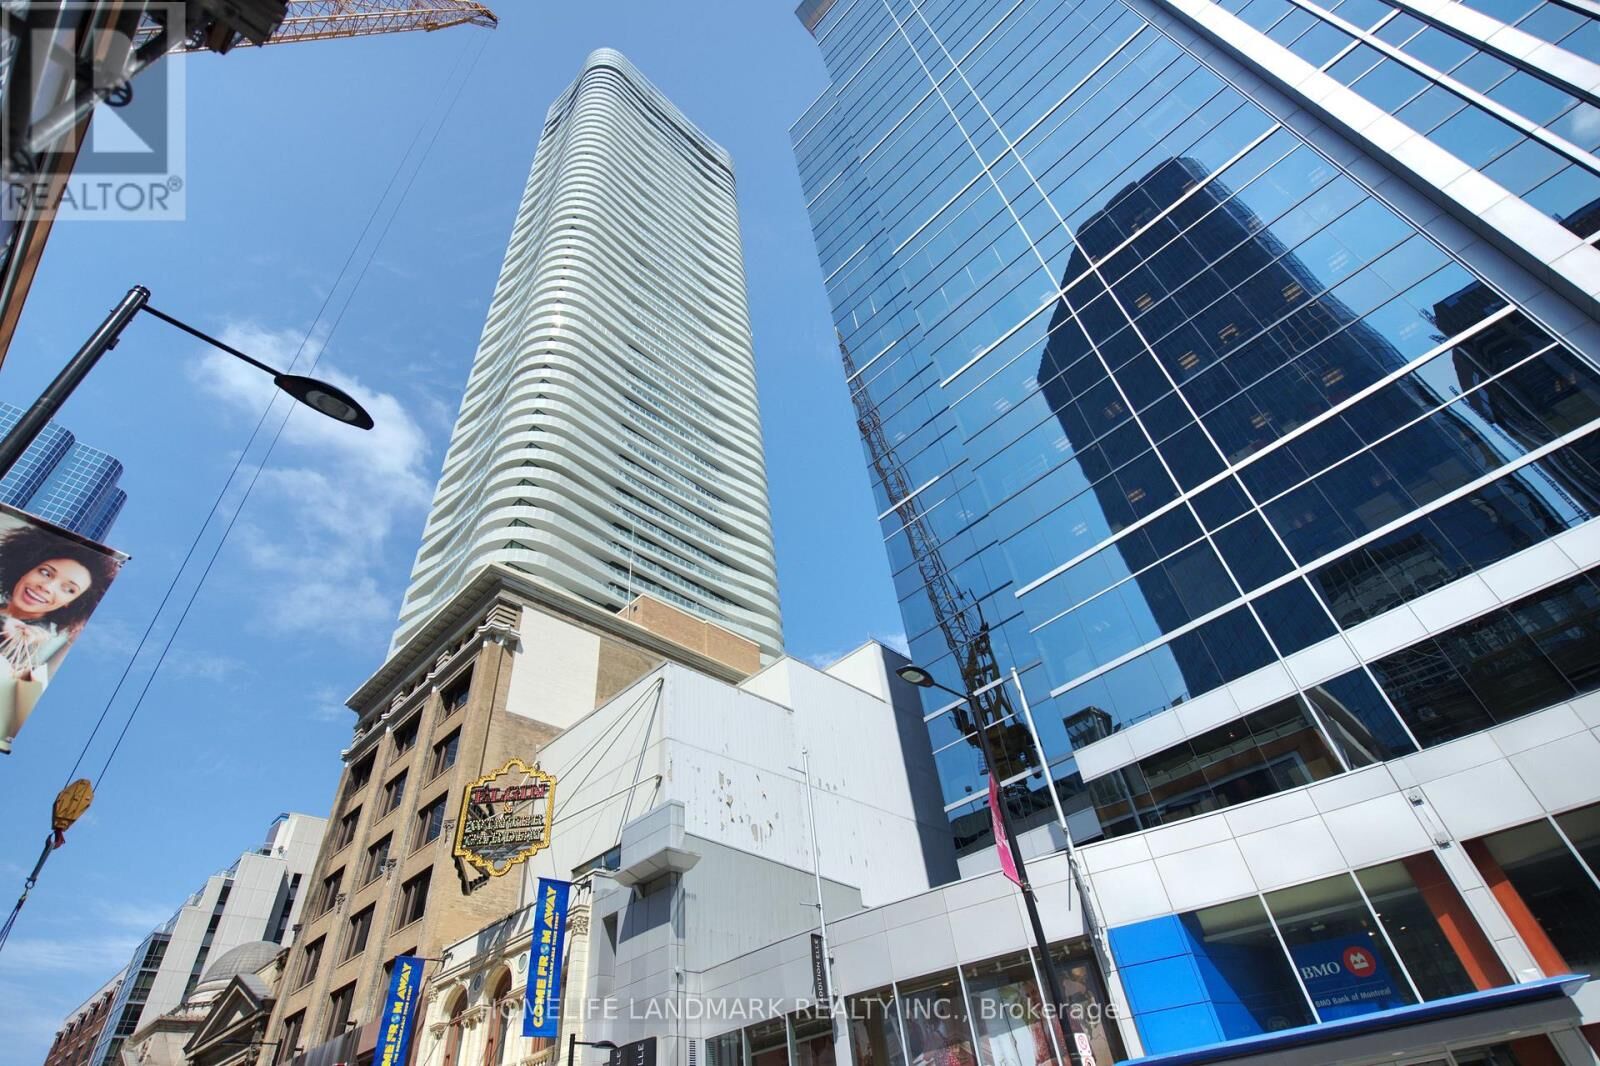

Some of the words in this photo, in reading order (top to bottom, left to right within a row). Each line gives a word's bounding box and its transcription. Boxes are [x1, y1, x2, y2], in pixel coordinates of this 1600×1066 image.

[471, 783, 549, 805] ELGIN
[544, 885, 556, 928] AWAY
[537, 929, 552, 976] FROM
[1301, 962, 1340, 979] BMO
[386, 1001, 404, 1042] FROM
[396, 961, 412, 1000] AWAY
[533, 978, 547, 1028] COME
[1314, 999, 1332, 1008] BMO
[1332, 994, 1351, 1004] Bank
[1351, 993, 1359, 1001] of
[1360, 986, 1392, 1000] Montreal
